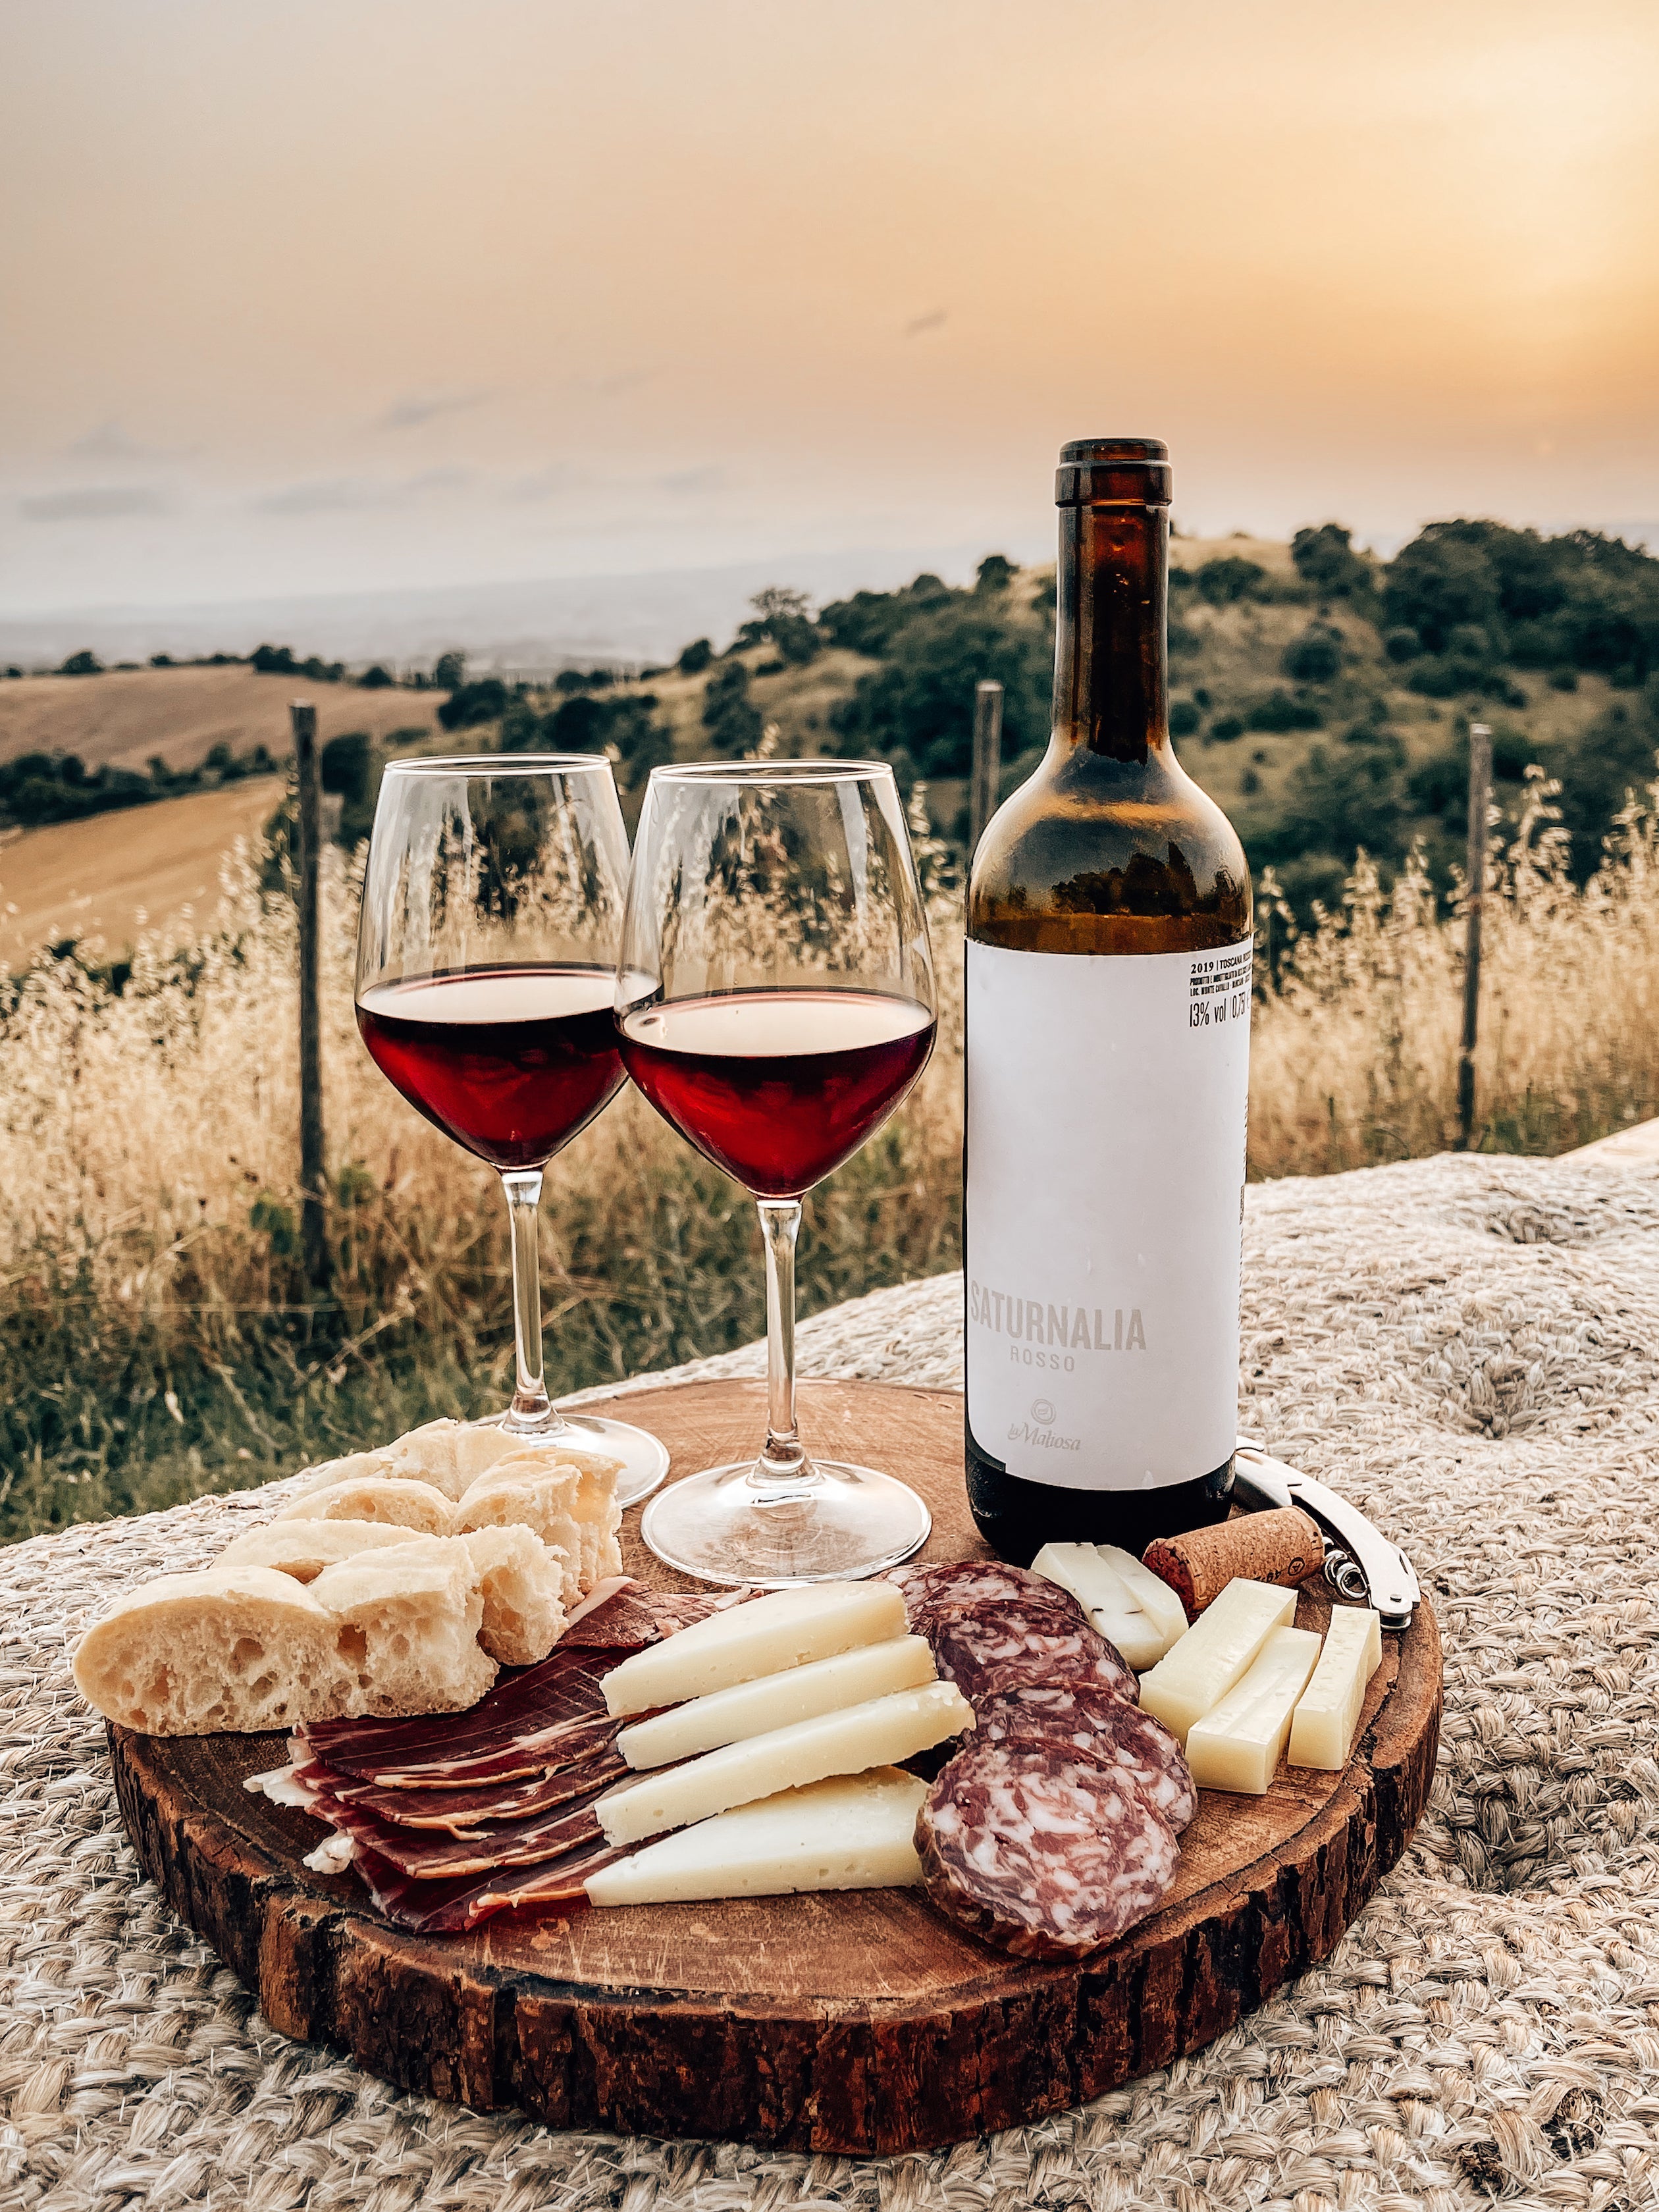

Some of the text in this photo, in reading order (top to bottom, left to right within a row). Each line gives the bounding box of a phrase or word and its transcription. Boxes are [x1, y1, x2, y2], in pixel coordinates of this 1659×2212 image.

[1191, 961, 1214, 974] 2019
[1220, 955, 1242, 969] TOSCANA
[1190, 1001, 1209, 1028] 13%
[1214, 997, 1226, 1023] vol
[970, 1280, 1147, 1350] SATURNALIA
[1011, 1345, 1075, 1372] ROSSO
[1021, 1422, 1081, 1450] Maliosa
